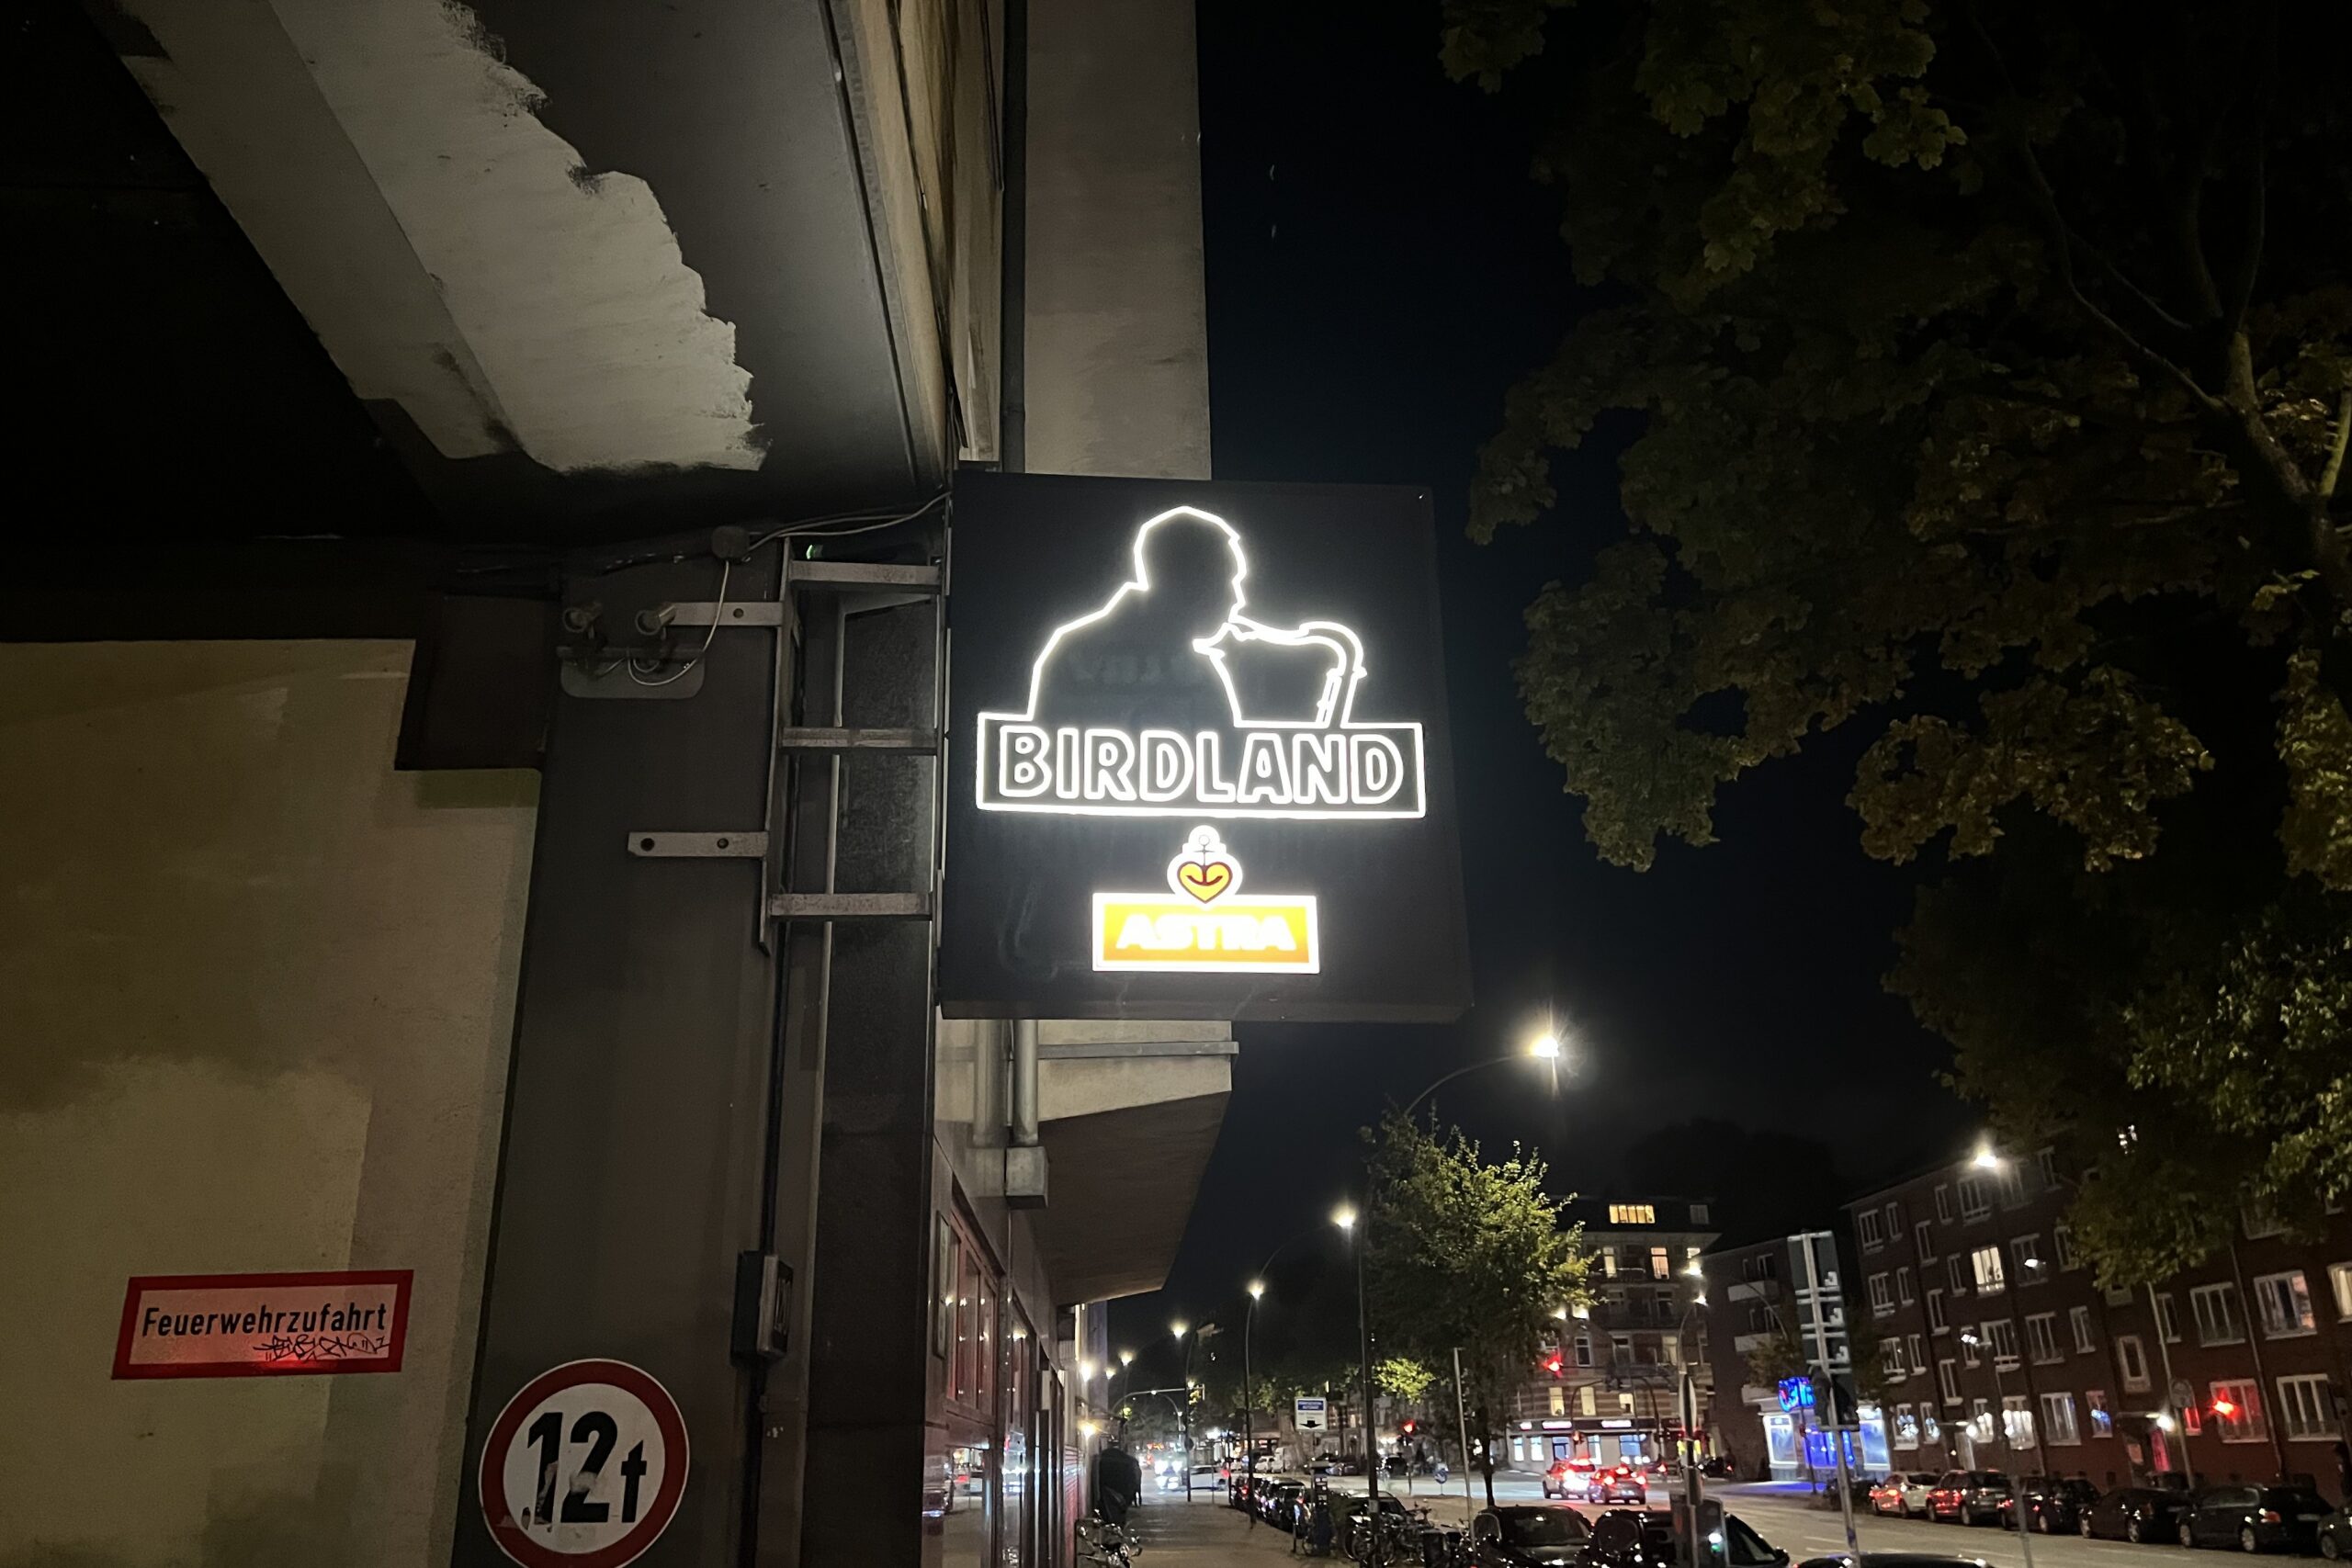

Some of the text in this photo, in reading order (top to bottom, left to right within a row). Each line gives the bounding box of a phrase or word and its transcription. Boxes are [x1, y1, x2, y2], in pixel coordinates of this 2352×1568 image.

[1000, 725, 1404, 805] BIRDLAND
[1115, 913, 1297, 951] ASTRA
[142, 1303, 387, 1337] Feuerwehrzufahrt
